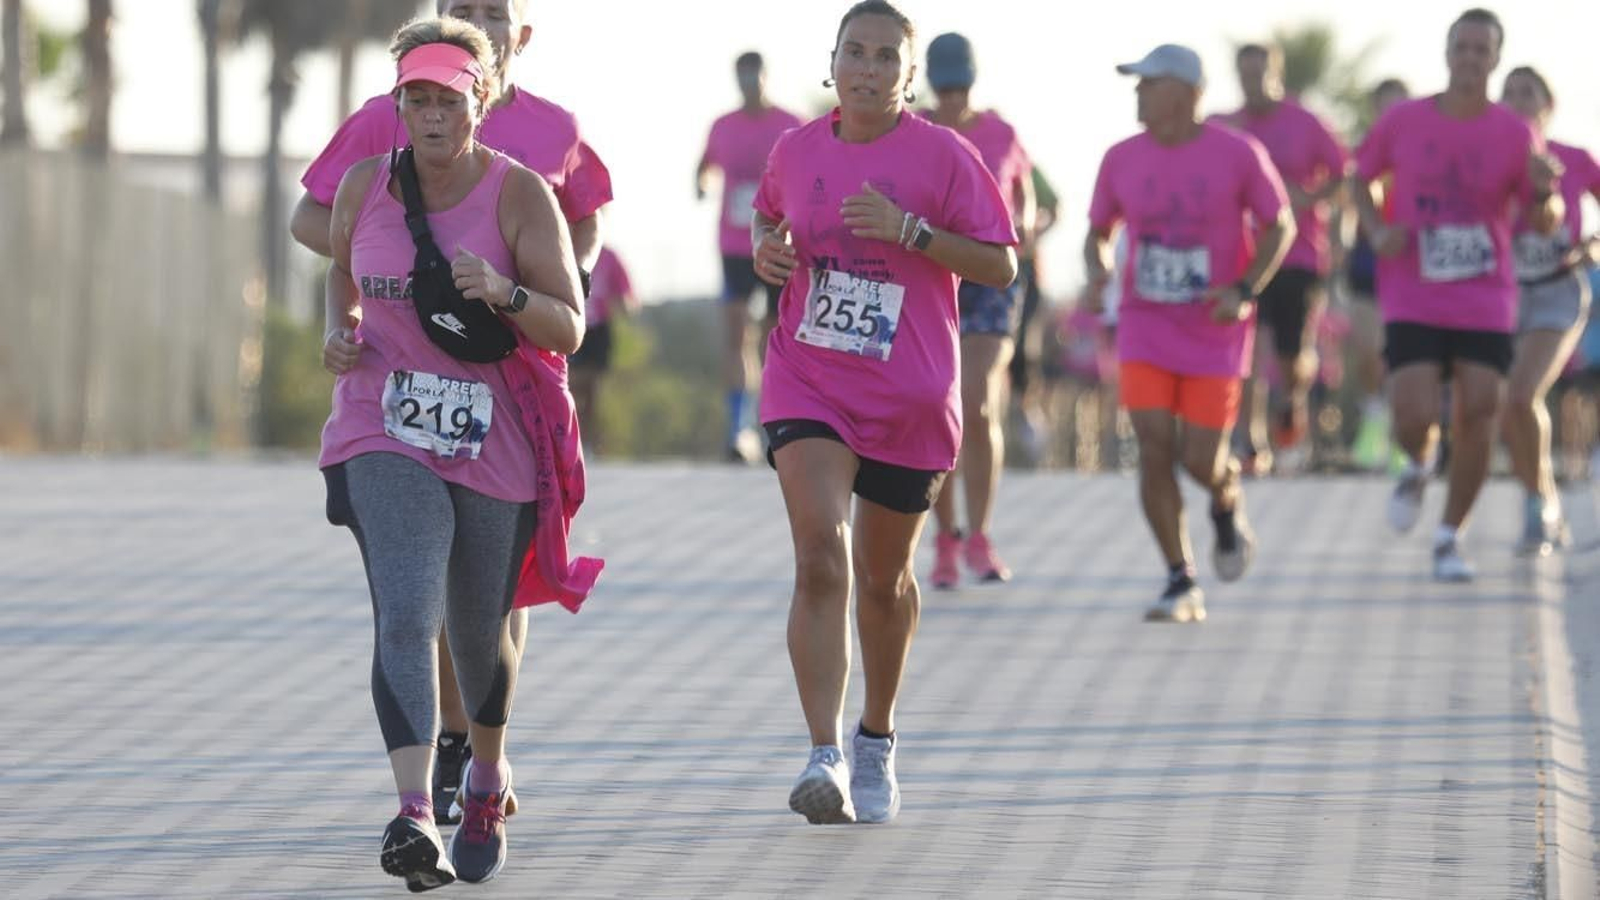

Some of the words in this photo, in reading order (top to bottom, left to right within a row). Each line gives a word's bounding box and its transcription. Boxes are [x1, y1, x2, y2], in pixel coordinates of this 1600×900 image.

[814, 294, 882, 338] 255
[393, 370, 414, 393] VI
[413, 386, 431, 395] POR
[399, 397, 473, 440] 219
